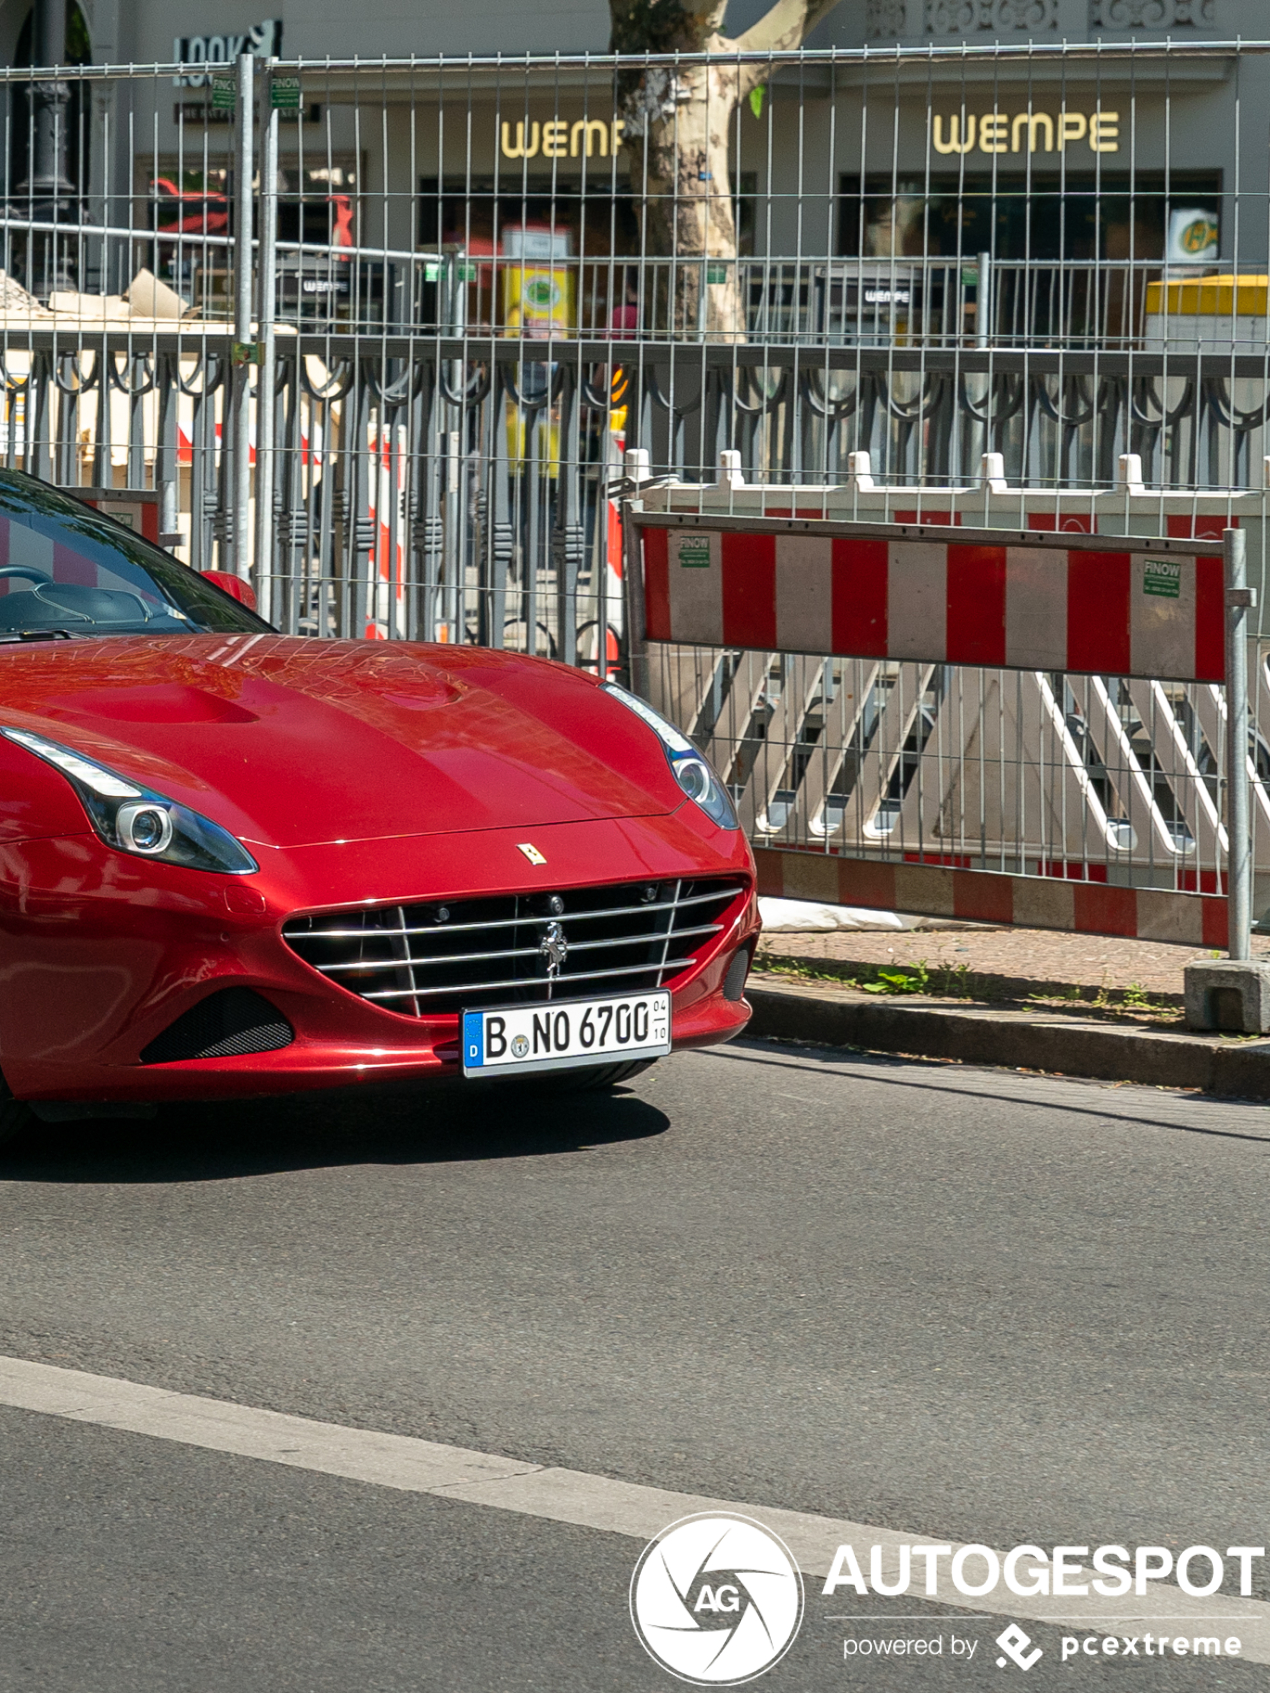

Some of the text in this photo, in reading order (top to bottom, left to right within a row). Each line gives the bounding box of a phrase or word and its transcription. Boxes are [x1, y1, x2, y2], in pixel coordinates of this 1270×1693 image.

[501, 119, 626, 159] WEMP
[933, 112, 1119, 154] WEMPE
[303, 280, 349, 292] WEMPE
[864, 290, 910, 303] WEMPE
[680, 537, 709, 548] FINOW
[1145, 561, 1180, 577] FINOW
[653, 1000, 666, 1012] 04
[486, 1001, 649, 1058] B NO 6700
[653, 1027, 666, 1040] 10
[469, 1045, 478, 1058] D
